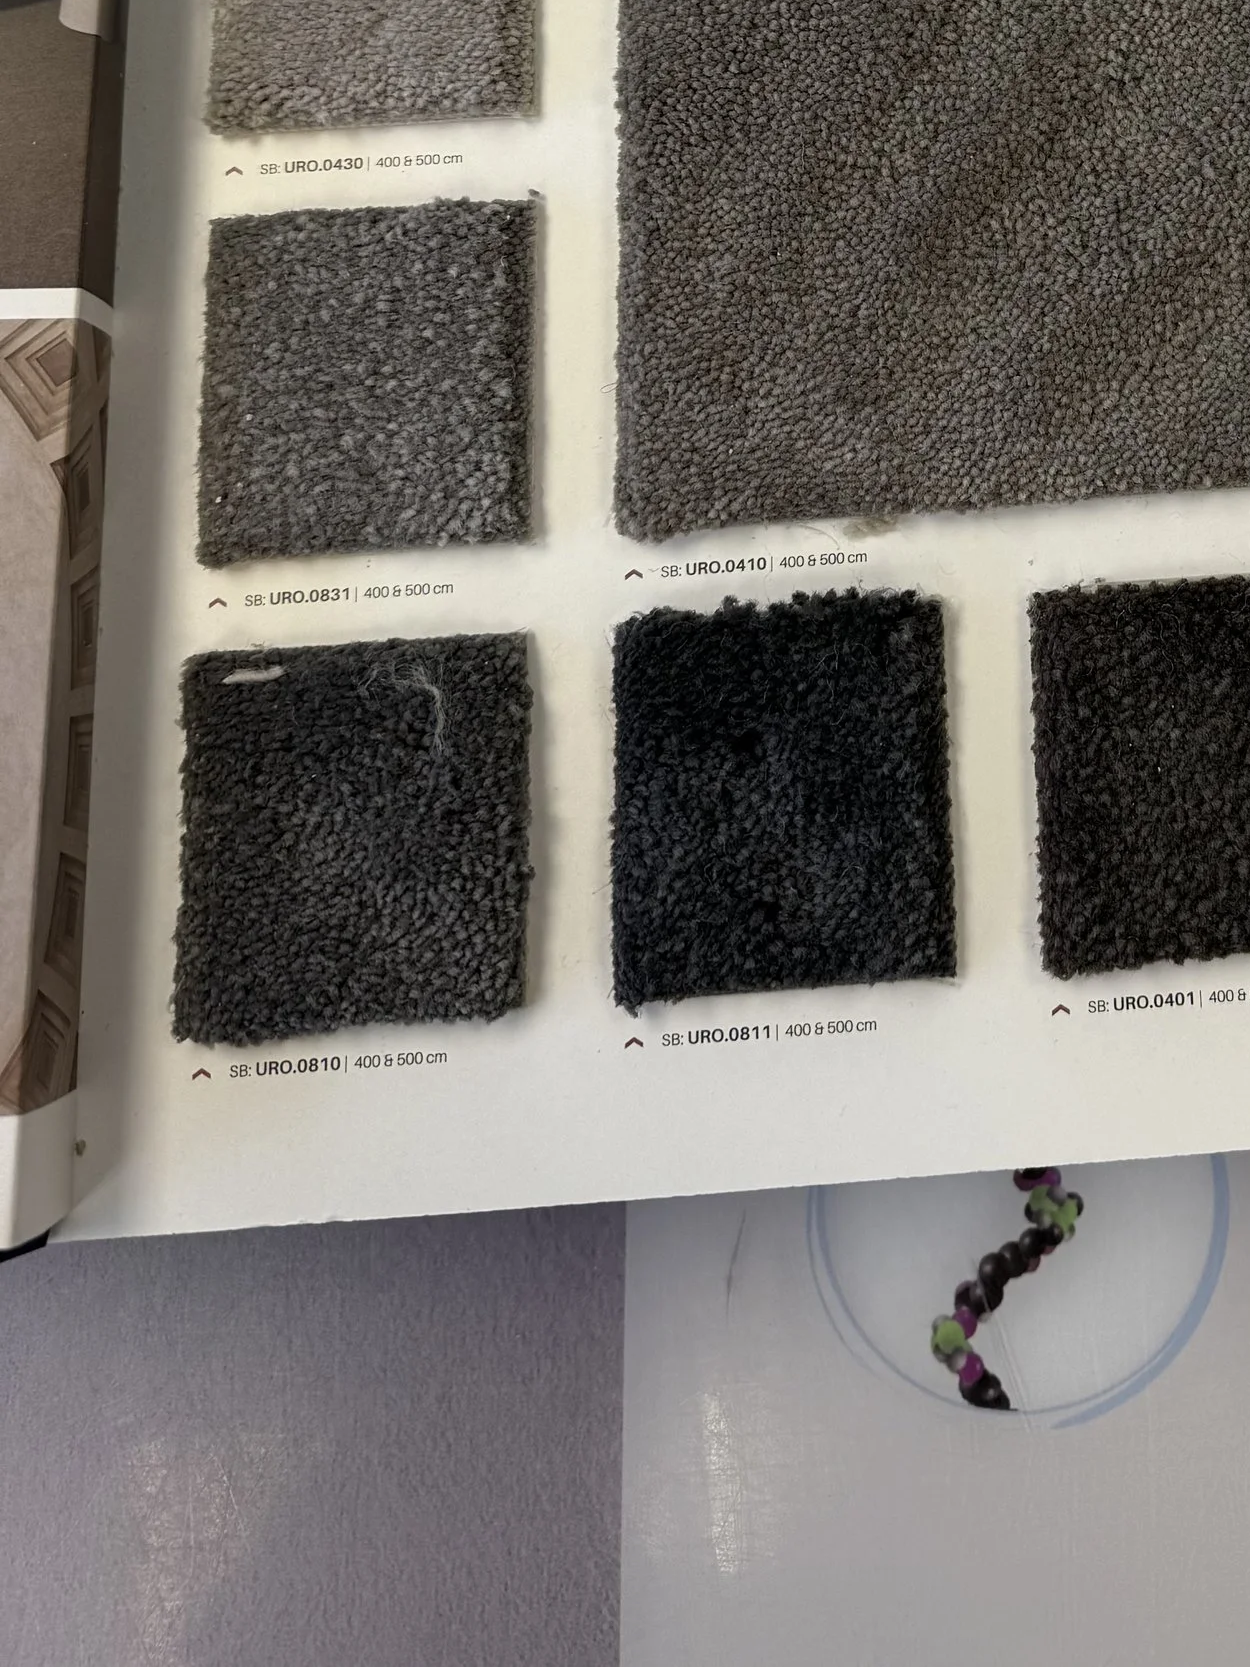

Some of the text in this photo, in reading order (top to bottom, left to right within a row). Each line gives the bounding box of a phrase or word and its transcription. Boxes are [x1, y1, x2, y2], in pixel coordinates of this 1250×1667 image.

[260, 157, 364, 175] SB: URO.0430
[660, 552, 868, 578] SB: URO.0410 400 & 500 cm
[244, 583, 454, 607] SB: URO.0831 400 & 500 cm
[1088, 999, 1110, 1014] SB:
[1113, 991, 1194, 1011] URO.0401
[1208, 989, 1234, 1004] 400
[1237, 988, 1247, 1001] &
[662, 1019, 877, 1047] SB: URO.0811 400 & 500 cm
[229, 1051, 448, 1078] SB: URO.0810 400 & 500 cm
